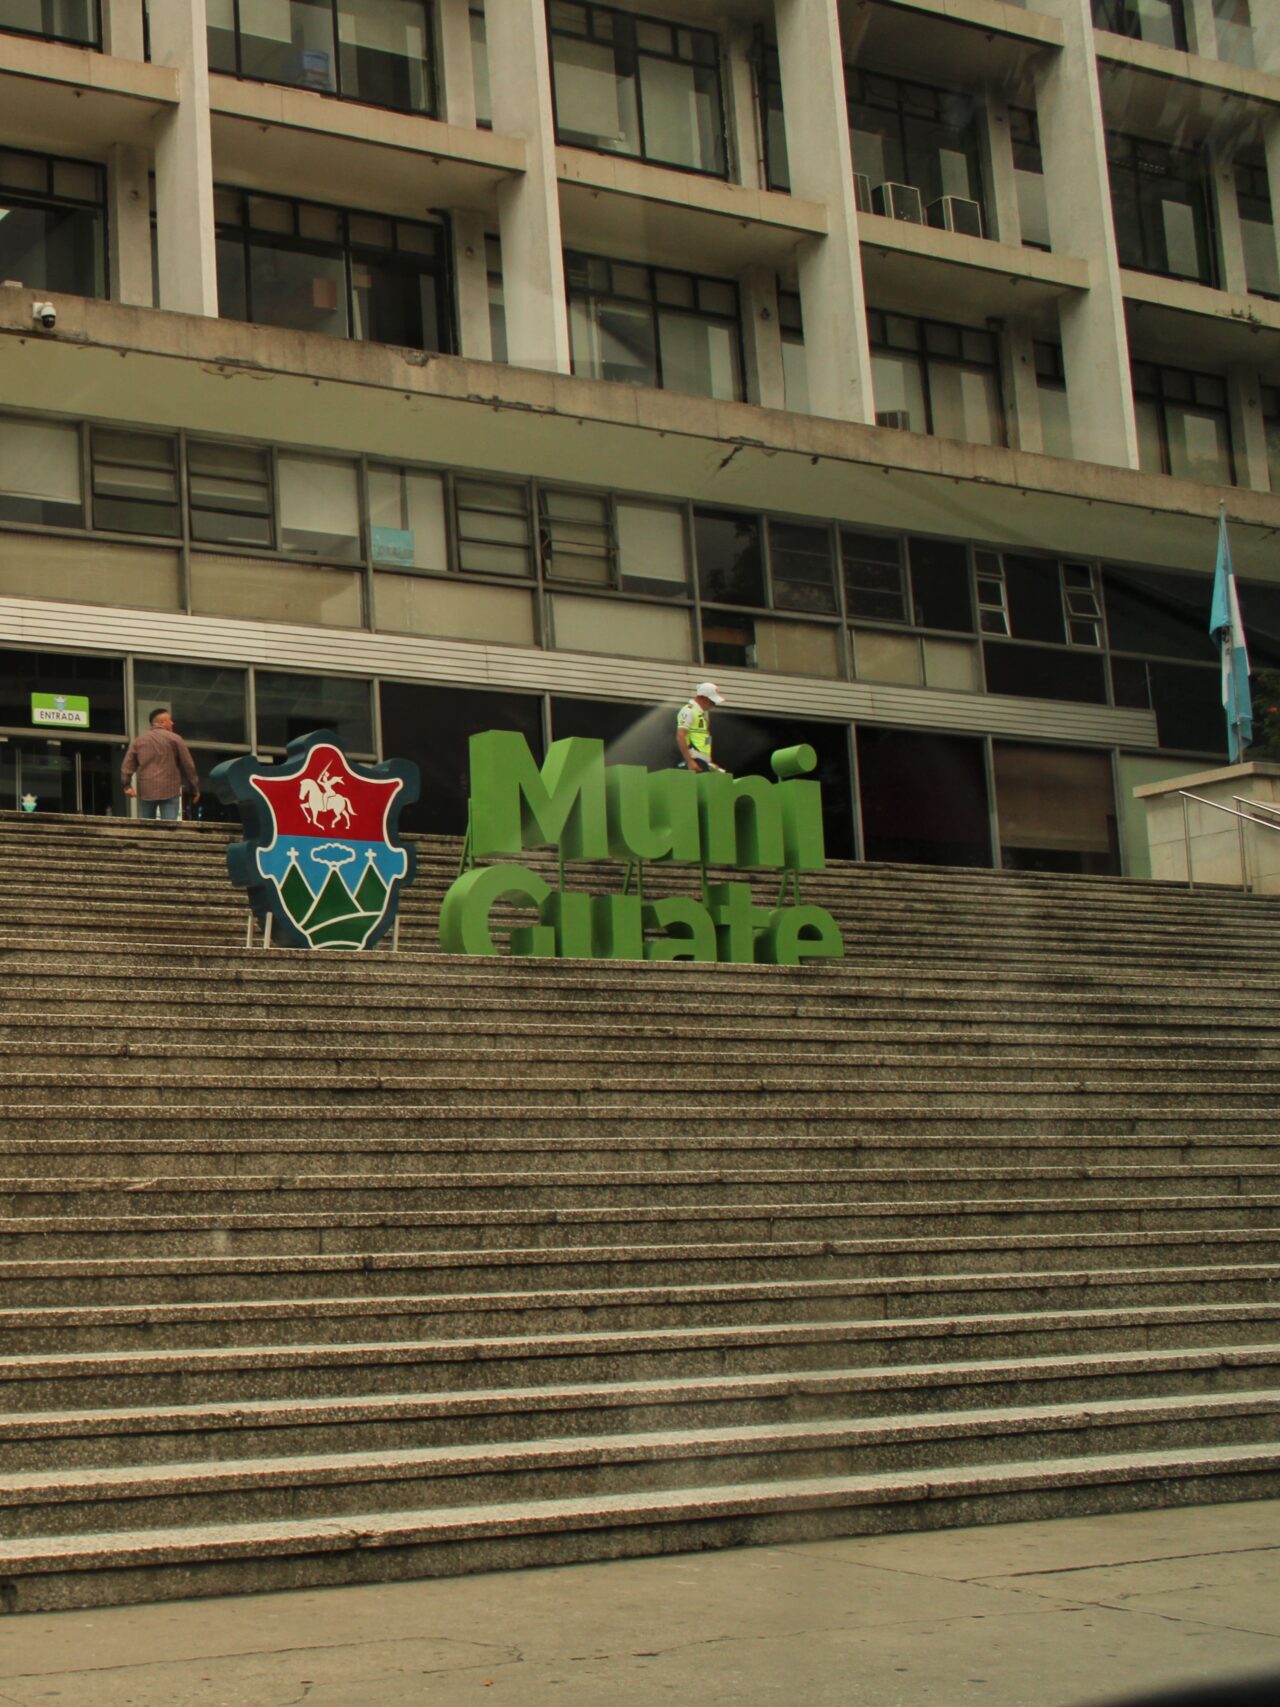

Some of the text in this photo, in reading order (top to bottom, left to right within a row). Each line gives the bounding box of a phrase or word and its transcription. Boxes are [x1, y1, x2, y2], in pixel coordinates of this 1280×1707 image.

[40, 711, 81, 721] ENTRADA
[469, 730, 825, 869] Muni
[440, 863, 844, 965] Guate
